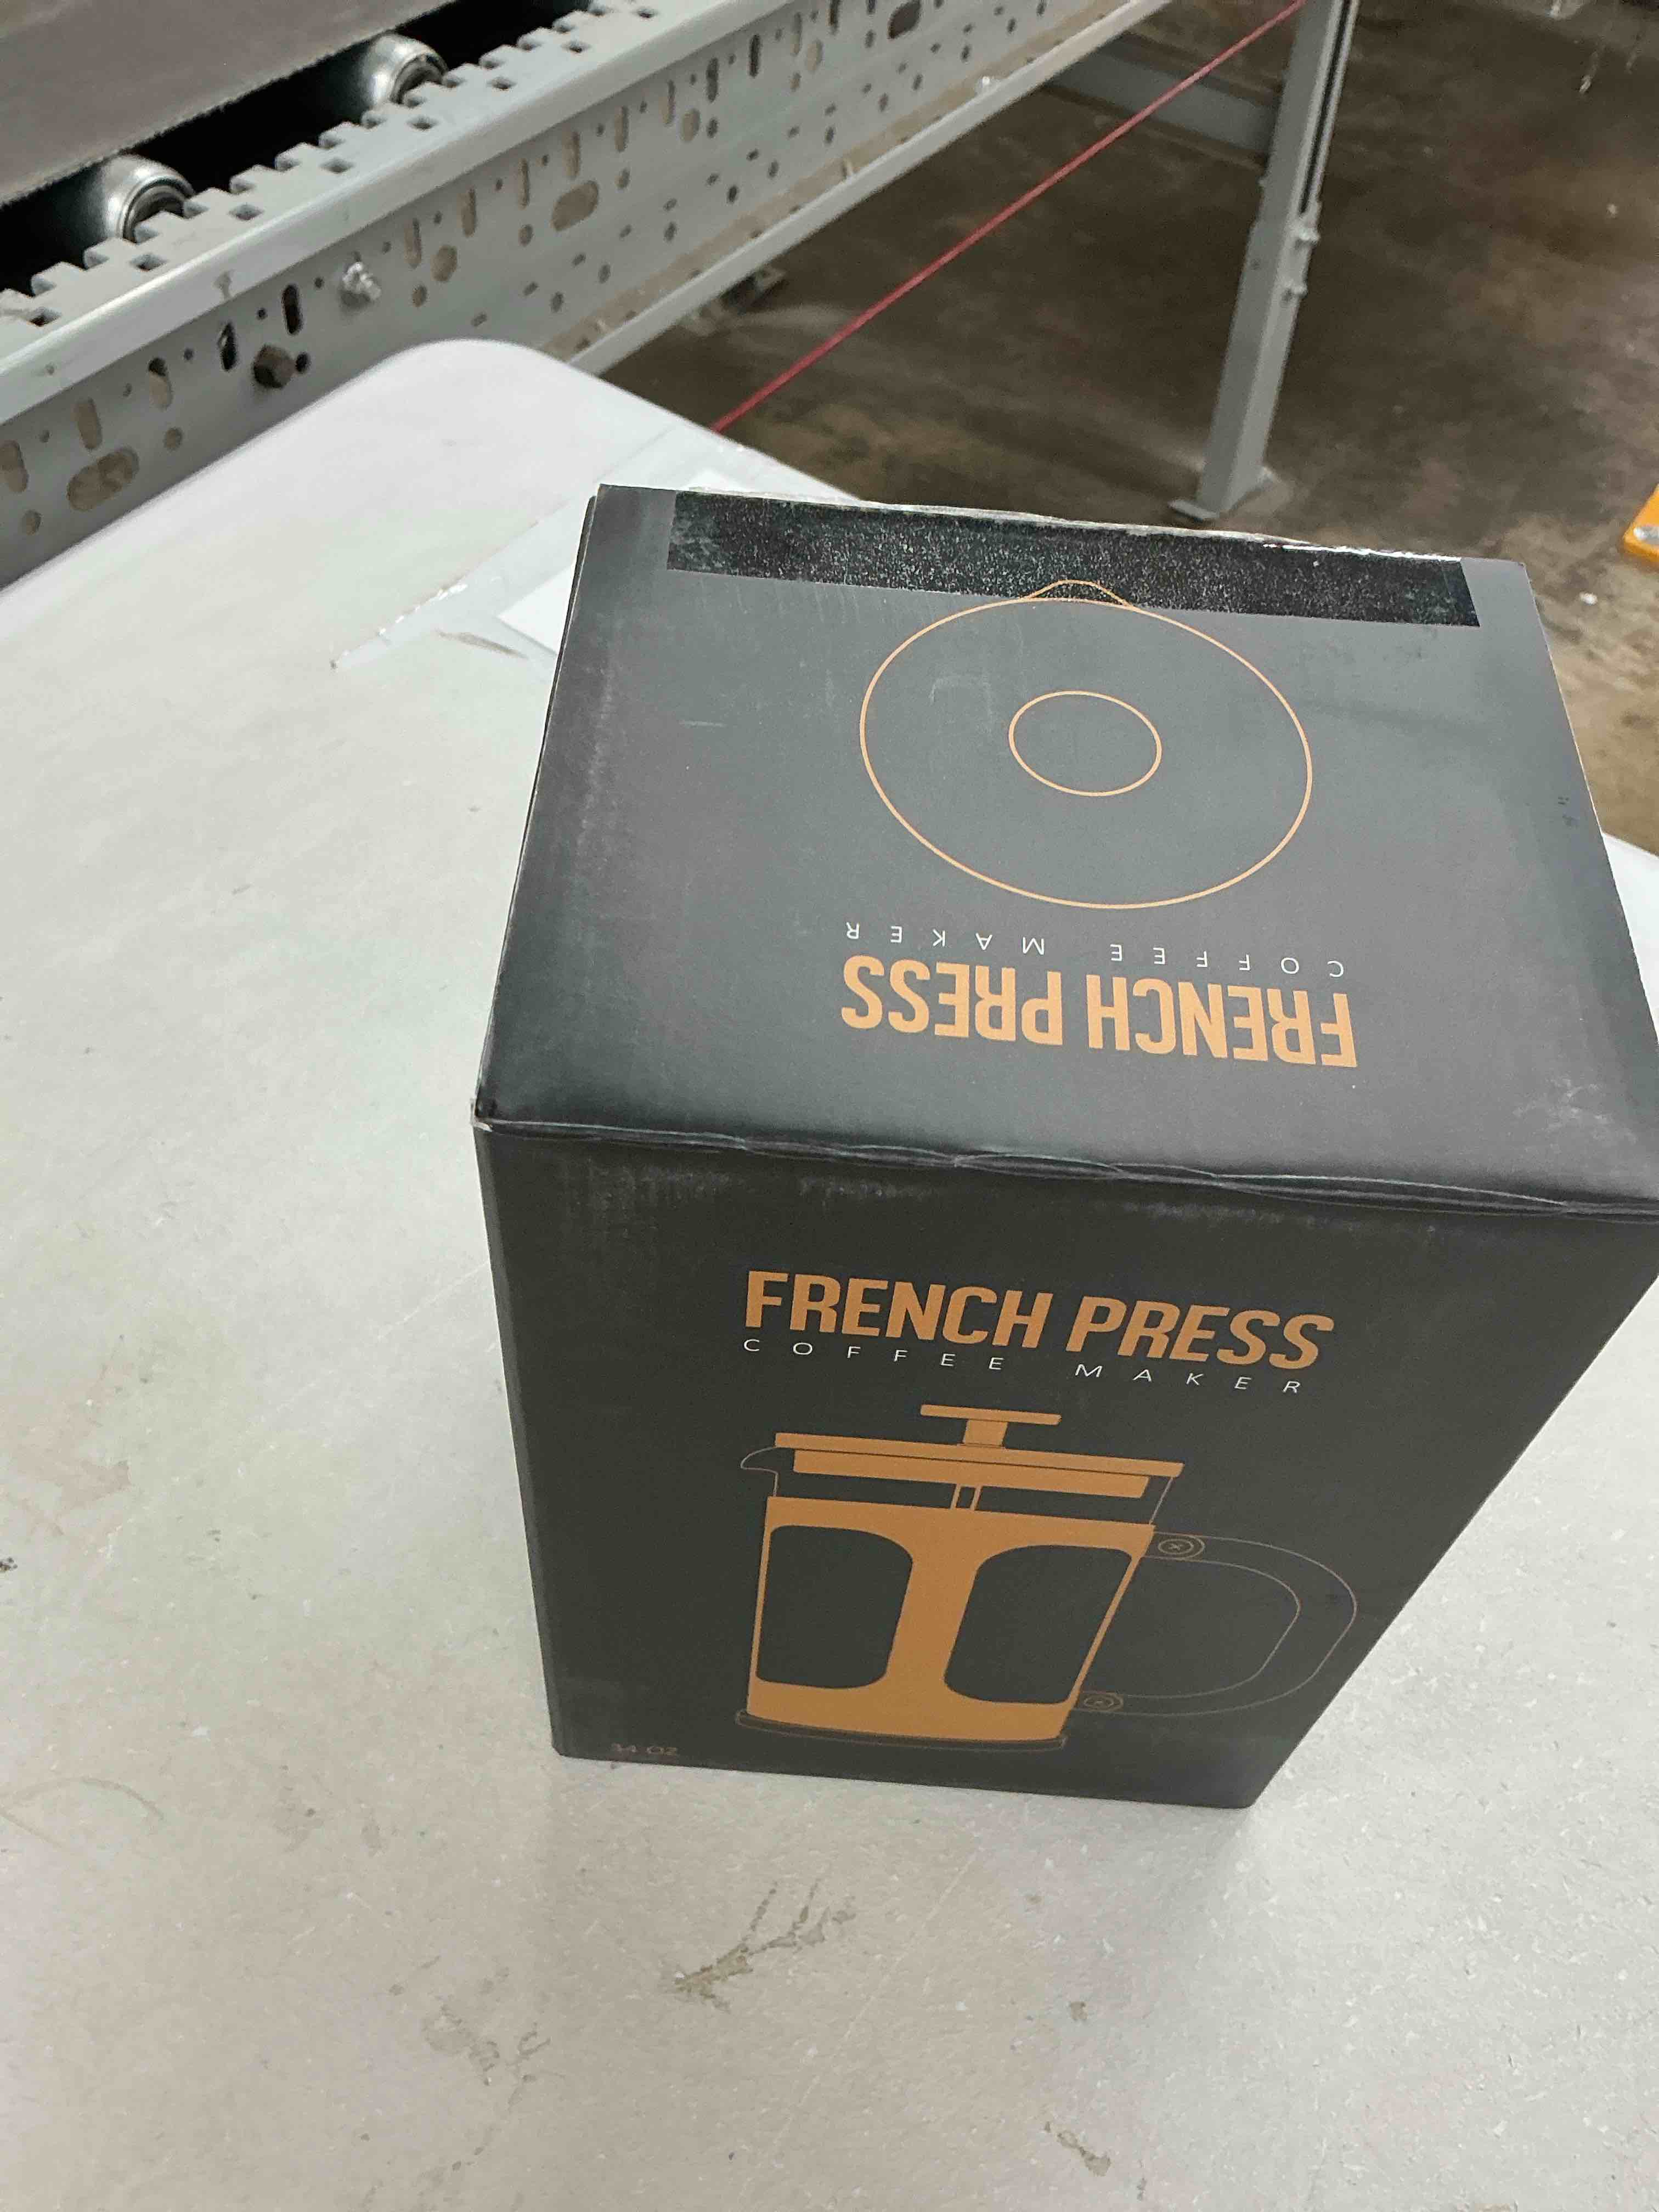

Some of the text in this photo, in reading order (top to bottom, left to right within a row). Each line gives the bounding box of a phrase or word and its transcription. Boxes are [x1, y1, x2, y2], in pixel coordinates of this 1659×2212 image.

[845, 922, 1344, 977] COFFEE MAKER
[840, 955, 1357, 1068] FRENCH PRESS
[744, 1270, 1334, 1370] FRENCH PRESS
[743, 1338, 1301, 1393] COFFEE MAKER
